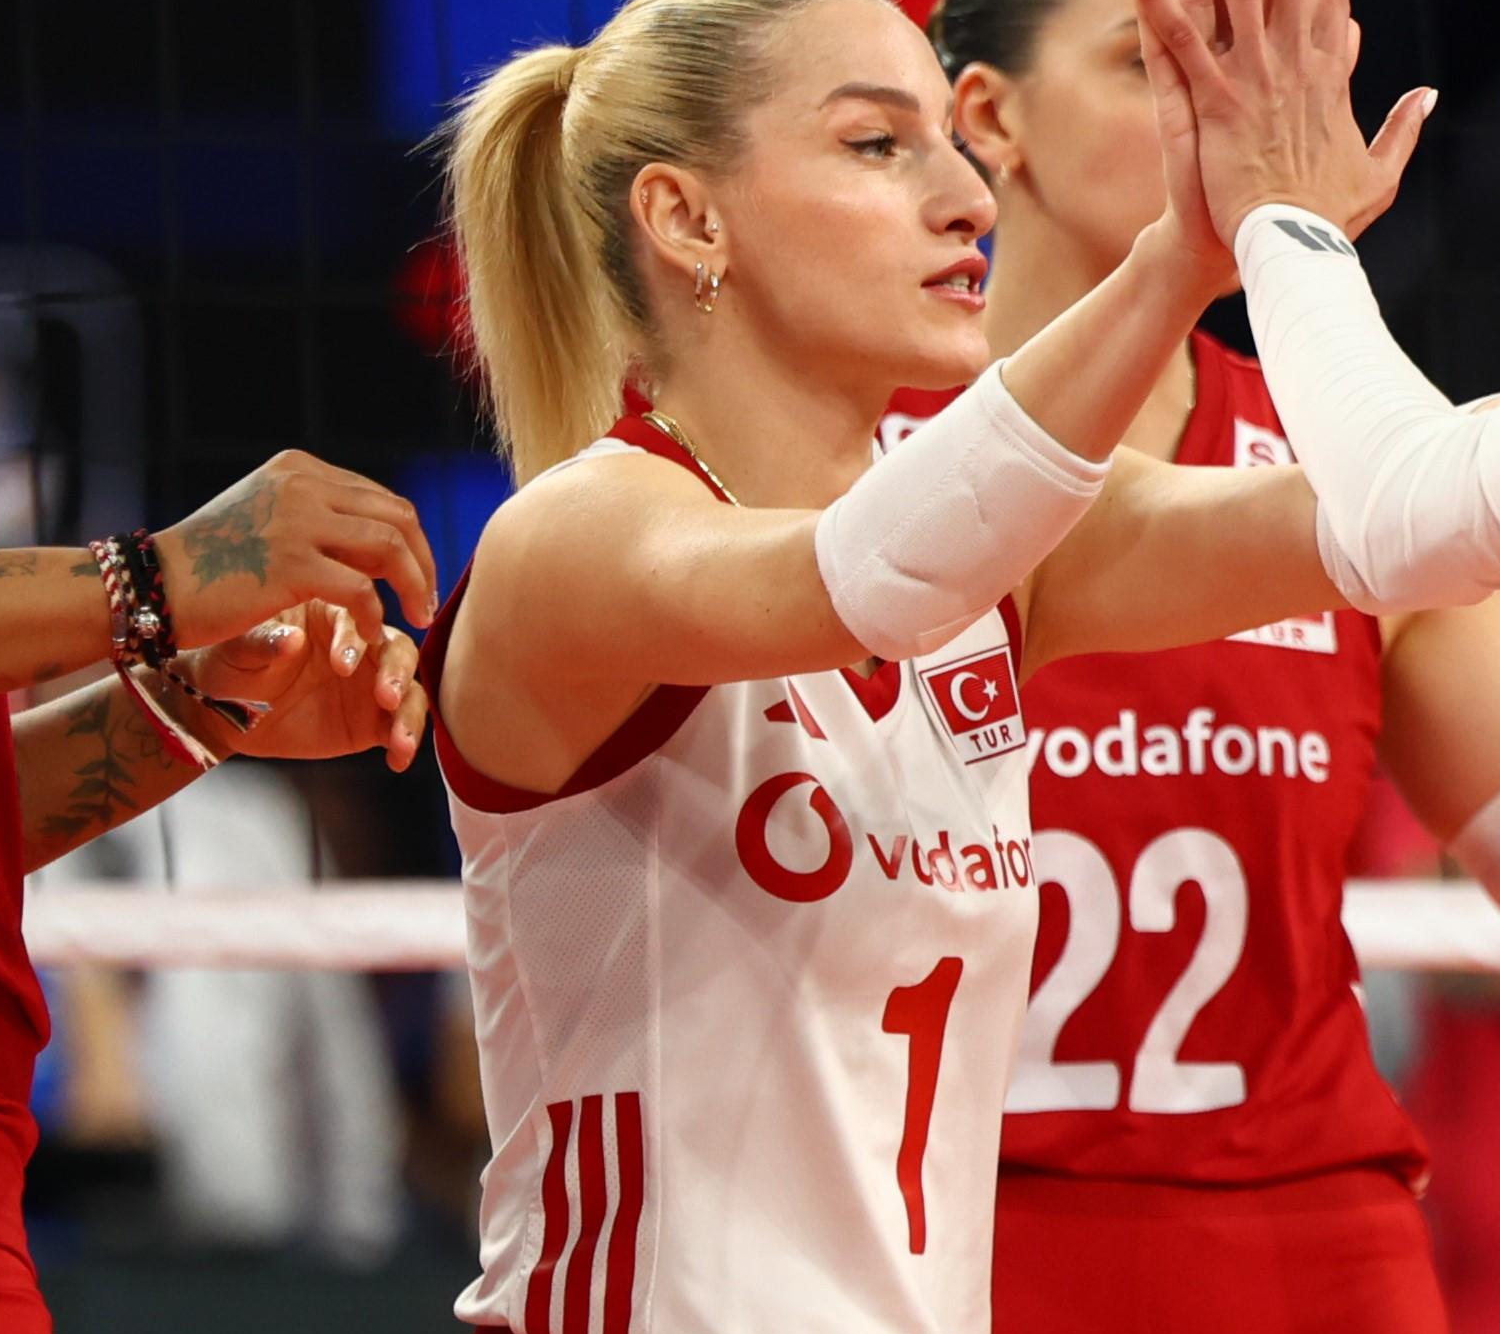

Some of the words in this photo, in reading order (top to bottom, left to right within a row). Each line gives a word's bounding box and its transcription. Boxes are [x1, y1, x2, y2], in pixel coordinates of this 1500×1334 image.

[968, 722, 1014, 754] TUR
[881, 955, 964, 1256] 1
[1003, 826, 1248, 1115] 22
